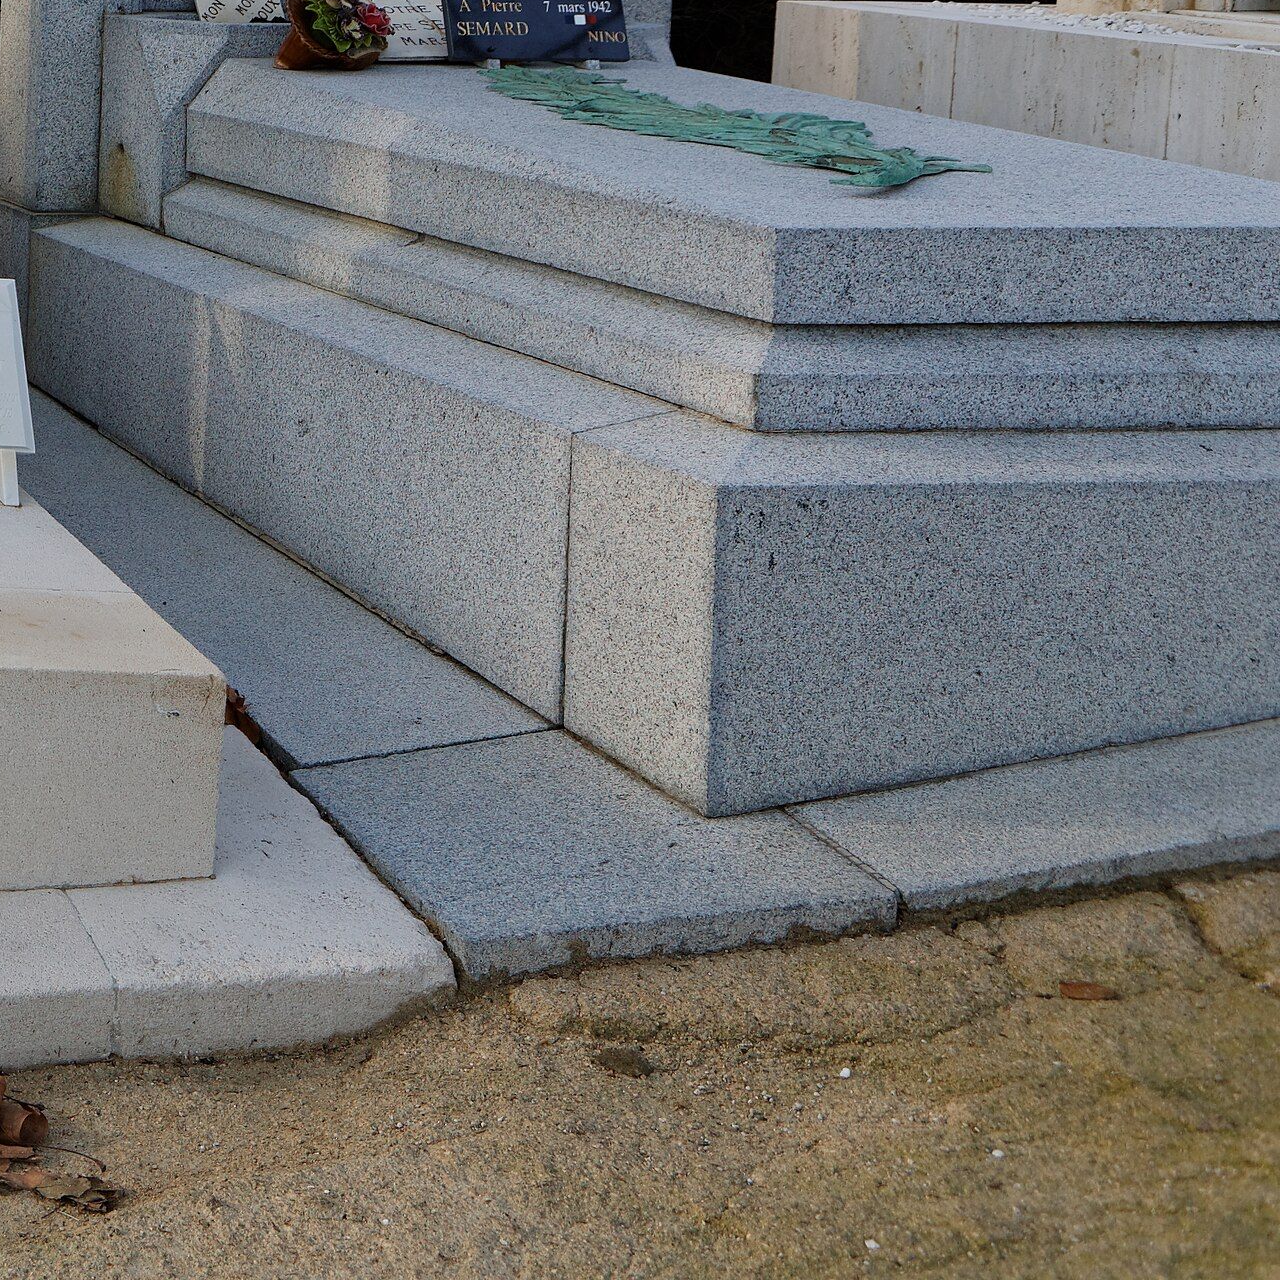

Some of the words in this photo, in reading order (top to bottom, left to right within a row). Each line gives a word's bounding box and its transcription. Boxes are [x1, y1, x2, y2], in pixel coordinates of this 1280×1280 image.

[387, 4, 426, 14] OTRE
[543, 1, 549, 12] 7
[558, 3, 585, 13] mars
[587, 0, 612, 13] 1942
[458, 21, 529, 36] SEMARD
[588, 31, 626, 44] NINO
